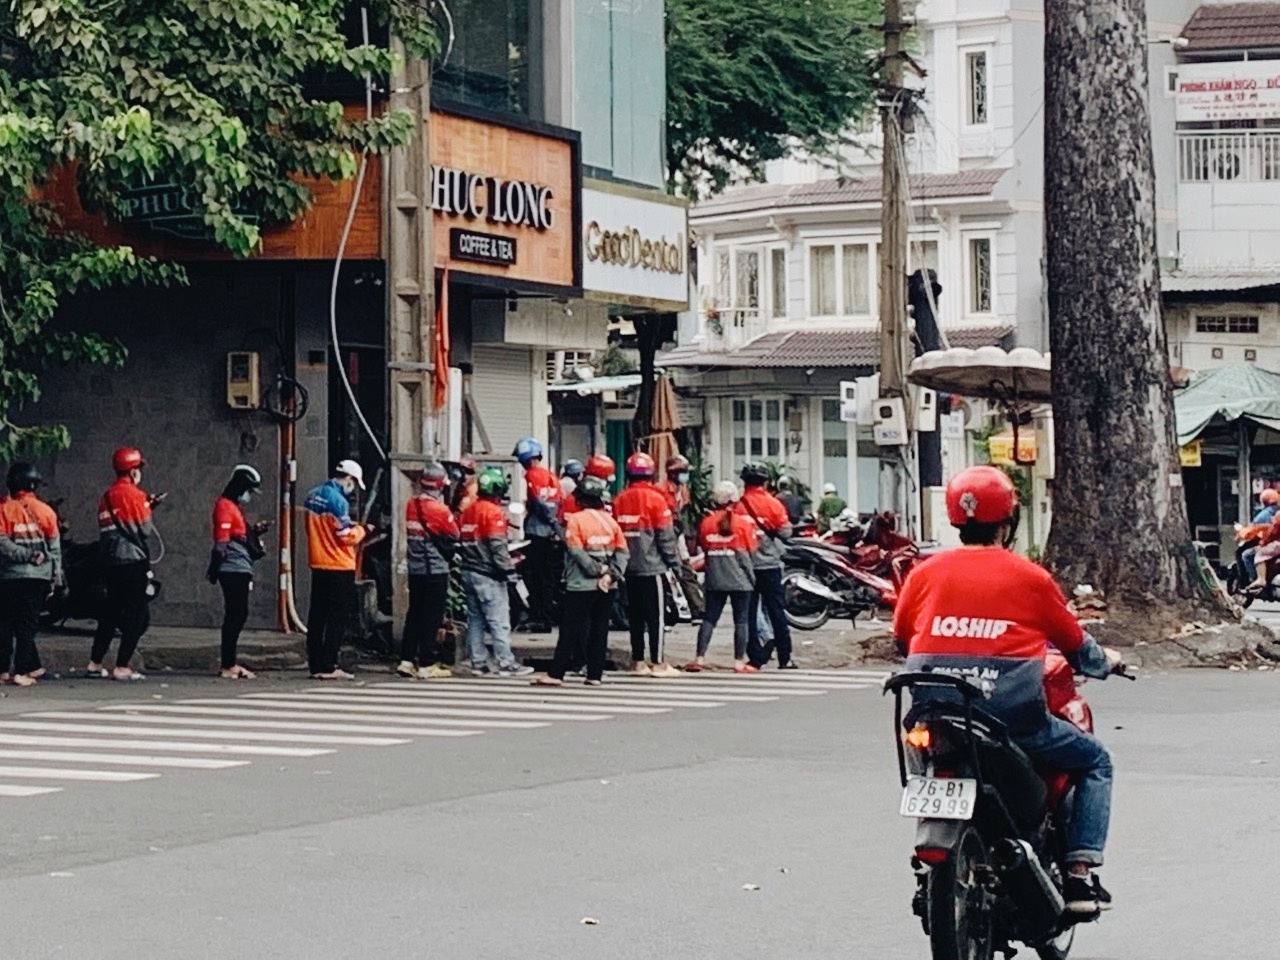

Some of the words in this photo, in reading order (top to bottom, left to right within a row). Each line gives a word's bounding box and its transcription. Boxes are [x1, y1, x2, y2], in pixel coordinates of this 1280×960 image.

[428, 163, 486, 218] HUC
[492, 177, 557, 230] LONG
[460, 233, 490, 257] COFFEE
[491, 239, 497, 257] &
[498, 240, 513, 259] TEA
[930, 615, 1018, 639] LOSHIP
[917, 780, 964, 797] 76-B1
